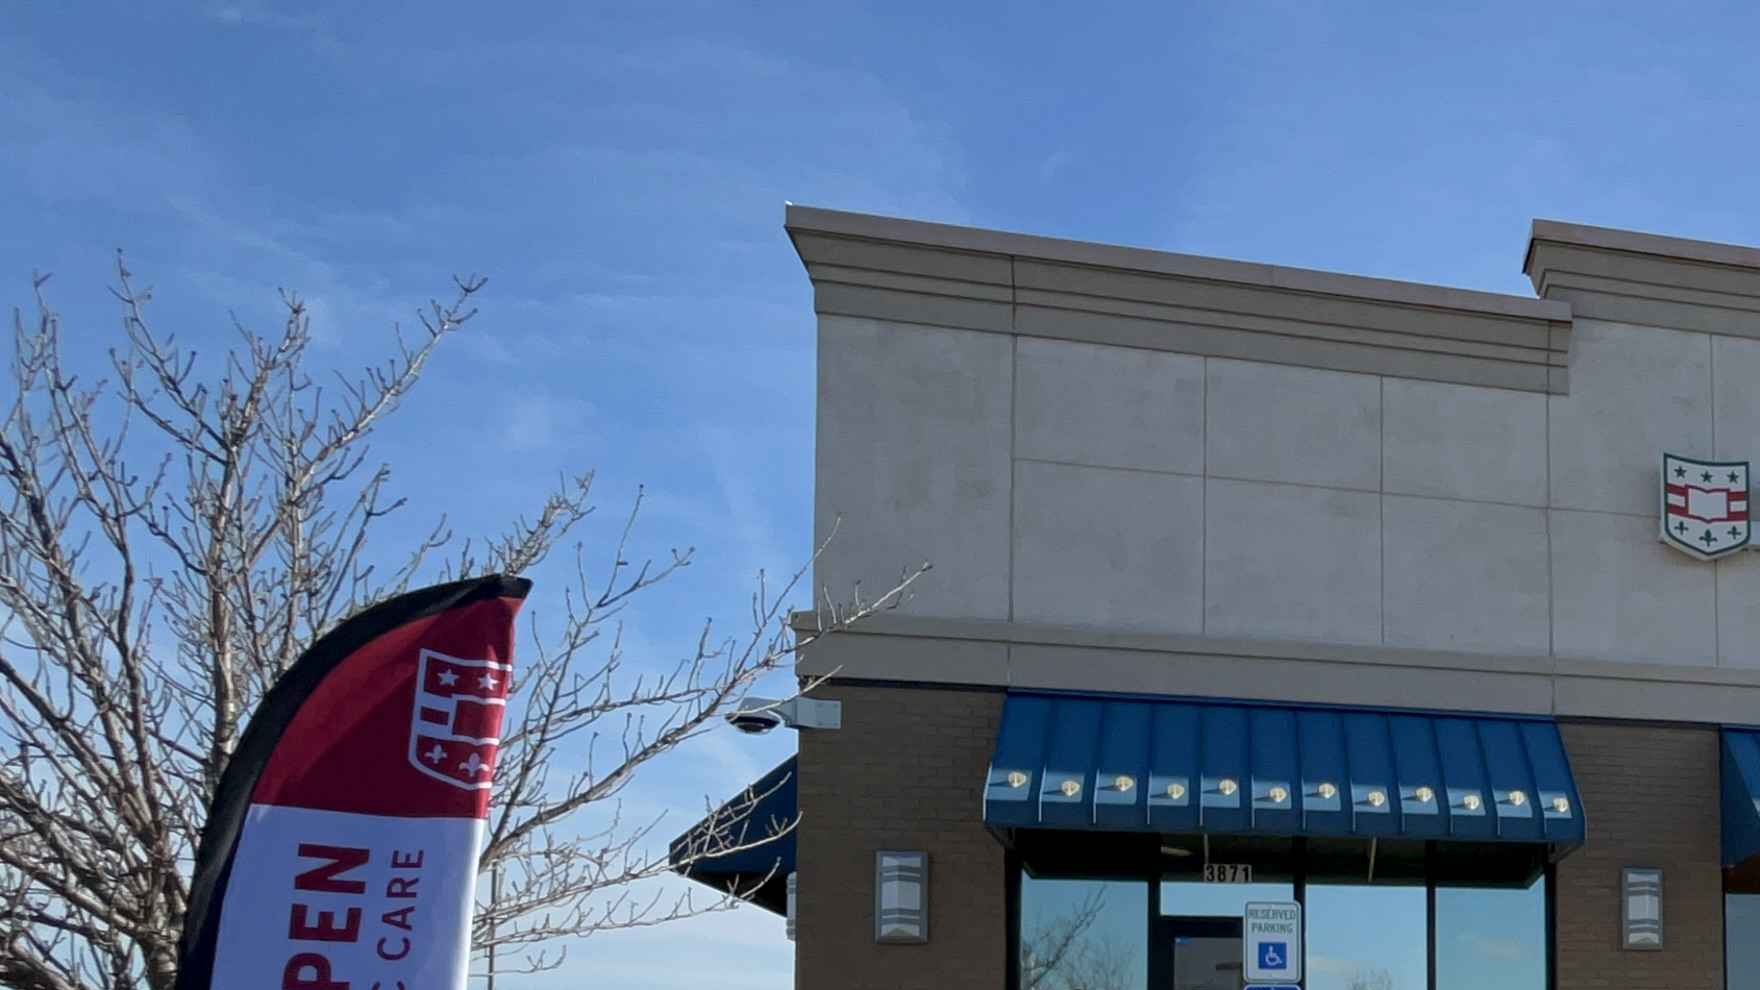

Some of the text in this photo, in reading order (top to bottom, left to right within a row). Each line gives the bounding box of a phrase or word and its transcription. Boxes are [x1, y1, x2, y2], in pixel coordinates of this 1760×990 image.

[1206, 864, 1250, 883] 3871
[376, 848, 425, 962] CARE
[1248, 908, 1296, 920] RESERVED
[1251, 922, 1293, 934] PARKING
